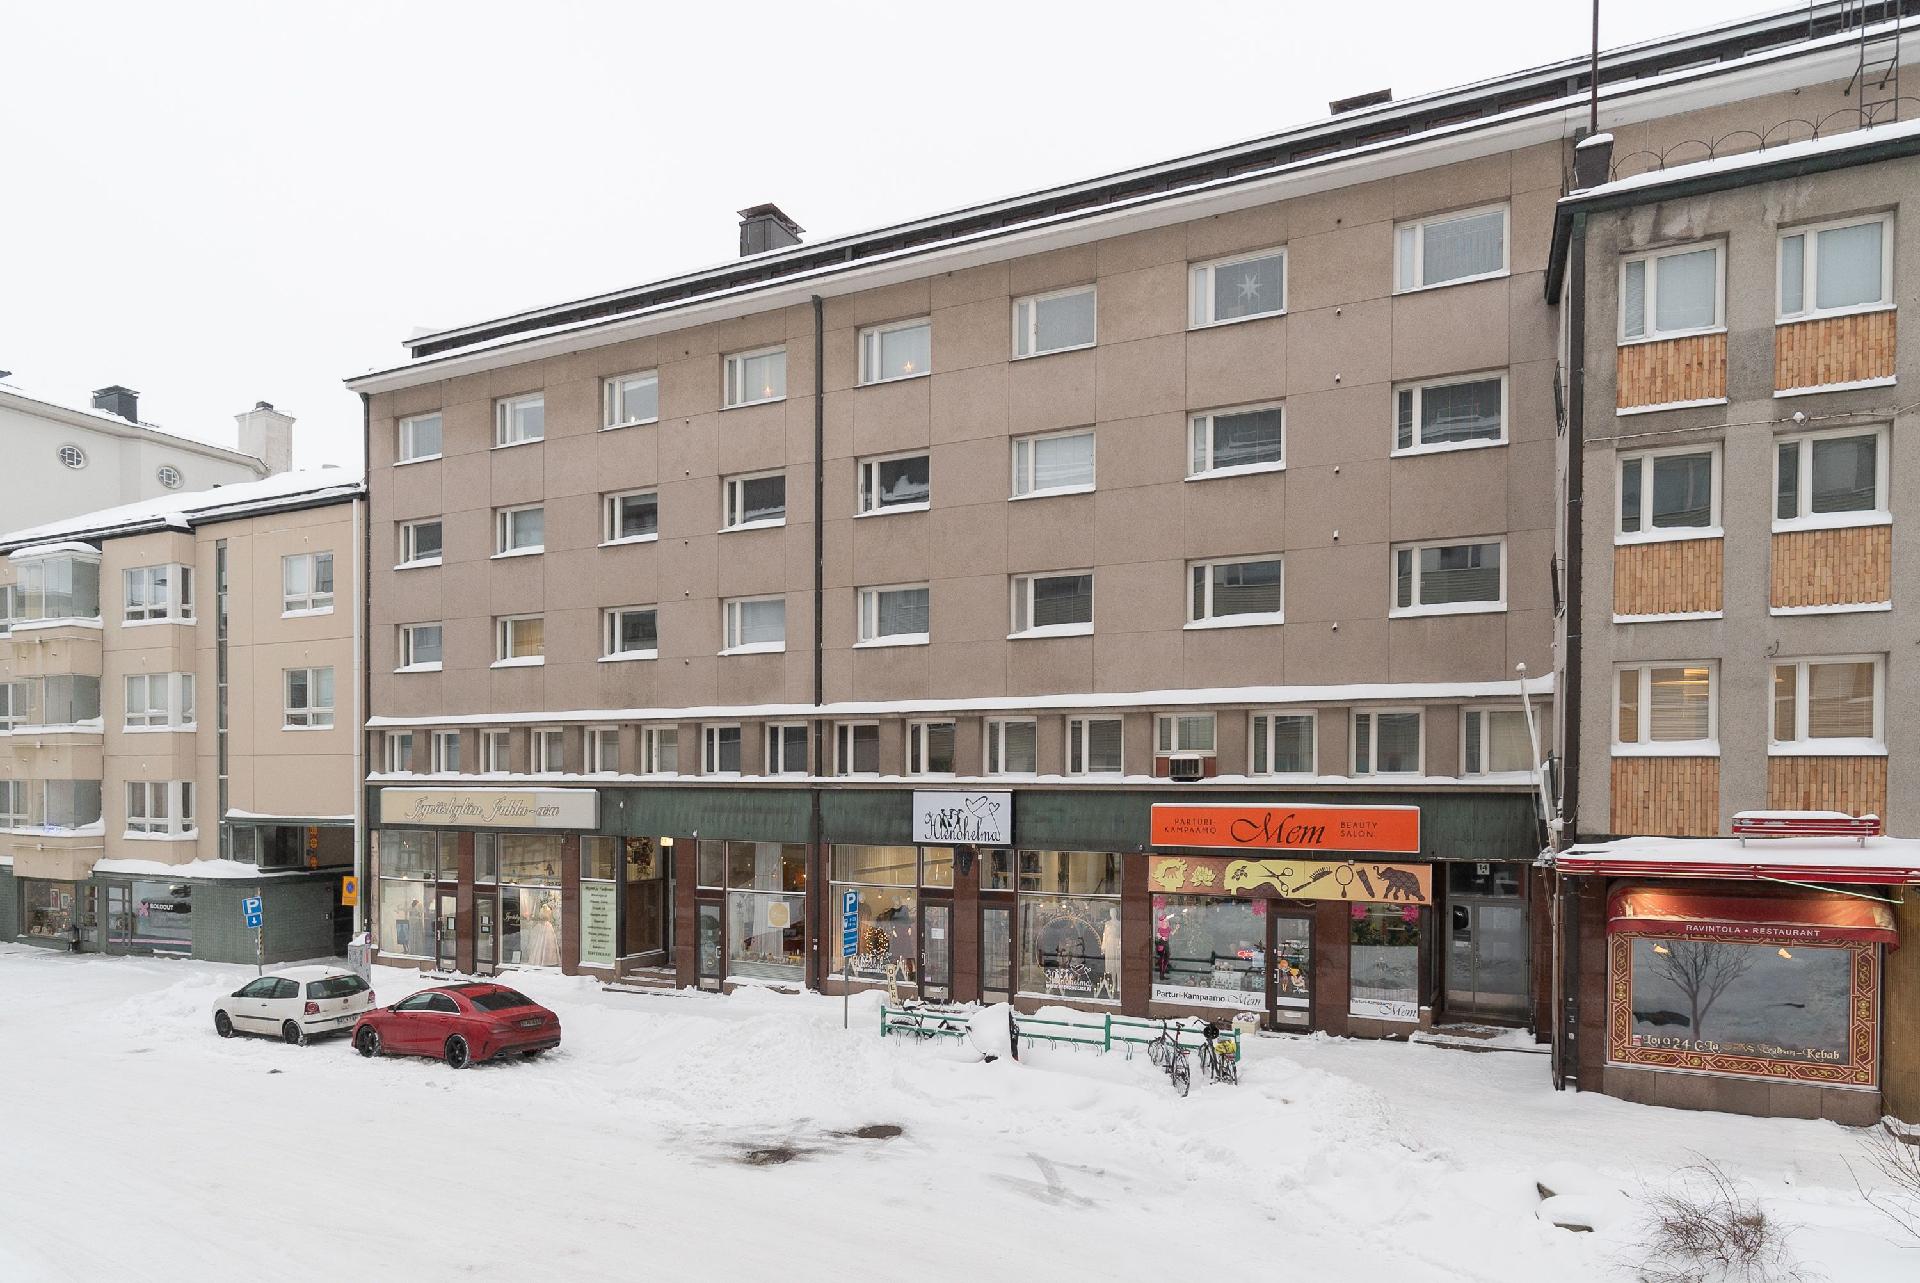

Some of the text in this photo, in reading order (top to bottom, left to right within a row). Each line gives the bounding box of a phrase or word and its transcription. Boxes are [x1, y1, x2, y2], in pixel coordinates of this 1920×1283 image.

[1164, 826, 1217, 835] KAMPAAMO
[1230, 811, 1326, 845] Mem
[1340, 820, 1378, 829] BEAUTY
[246, 899, 260, 913] P
[845, 892, 857, 913] P
[1685, 924, 1821, 937] RAVINTOLA RESTAURANT
